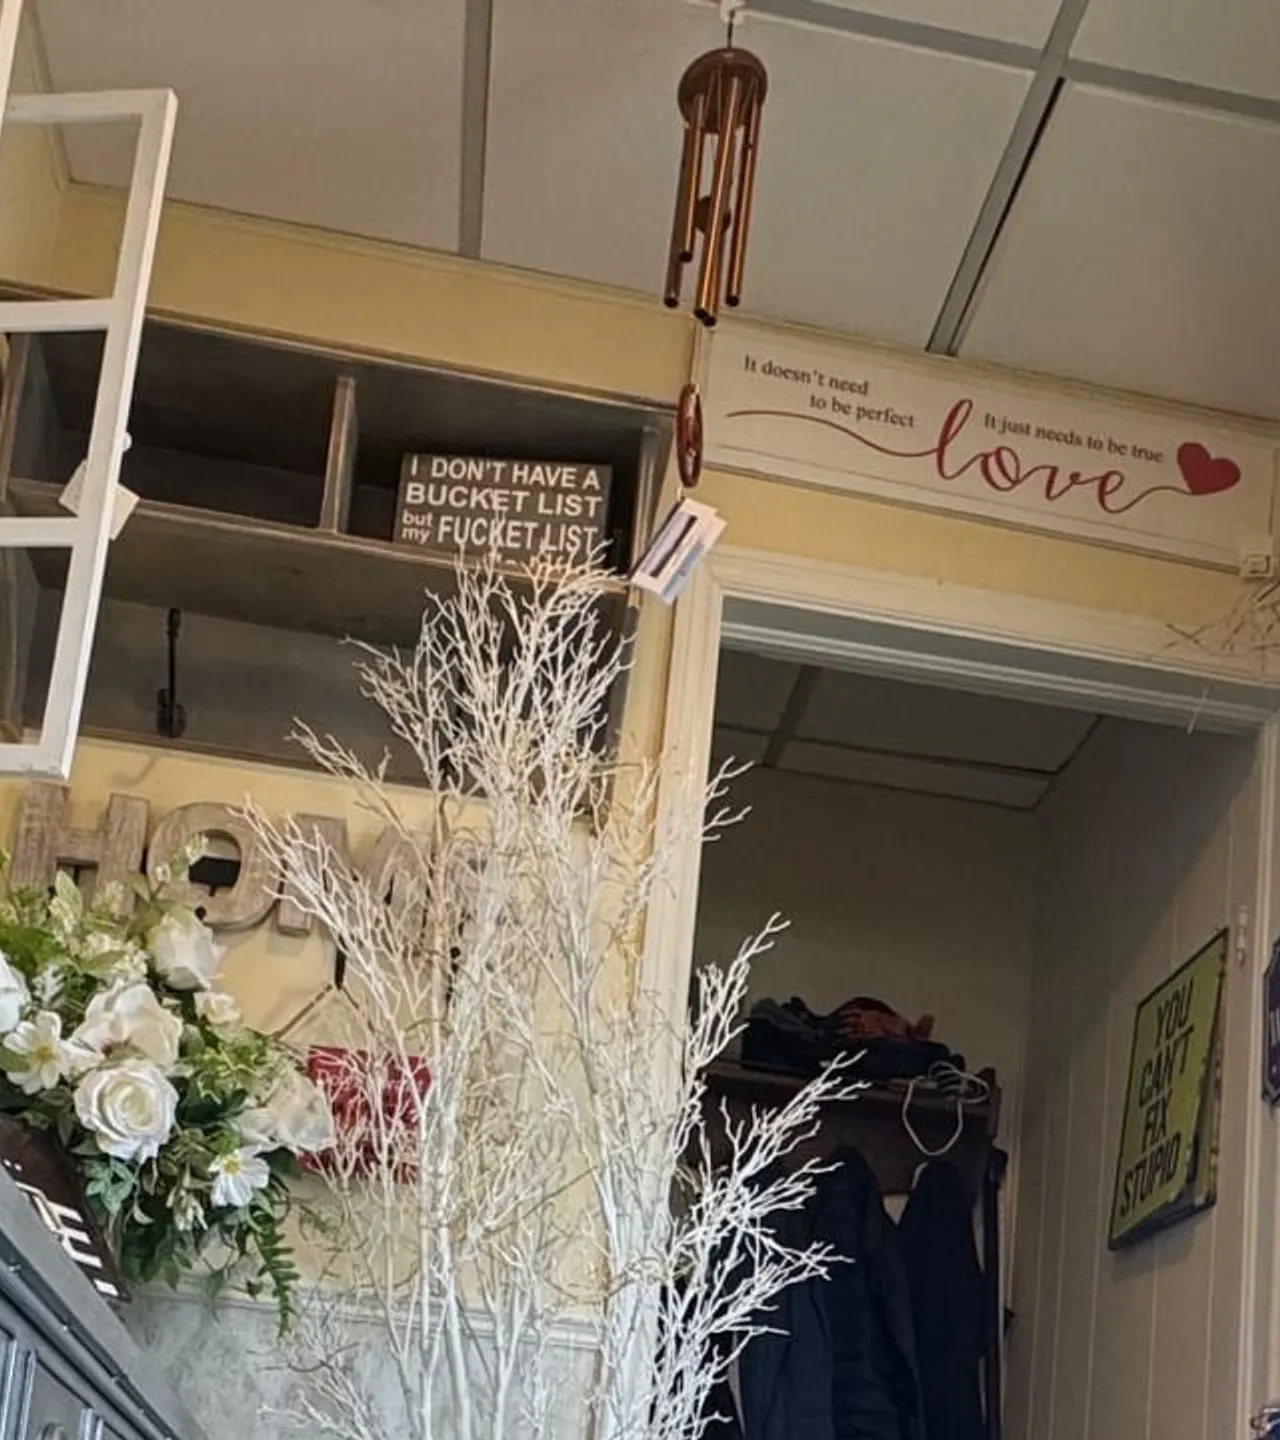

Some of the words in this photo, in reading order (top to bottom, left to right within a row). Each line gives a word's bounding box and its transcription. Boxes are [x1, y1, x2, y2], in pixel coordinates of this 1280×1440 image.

[743, 354, 757, 374] It
[761, 360, 825, 387] doesn't
[829, 375, 869, 396] need
[809, 394, 827, 409] to
[831, 396, 852, 416] be
[855, 405, 915, 429] perfect
[932, 399, 1130, 514] love
[984, 412, 996, 429] It
[999, 416, 1031, 435] just
[1035, 425, 1083, 448] needs
[1087, 435, 1103, 451] to
[1107, 437, 1128, 456] be
[1131, 444, 1164, 463] true
[411, 454, 418, 476] I
[431, 457, 506, 483] DON'T
[512, 464, 577, 489] HAVE
[582, 468, 600, 490] A
[402, 509, 433, 526] but
[406, 482, 530, 513] BUCKET
[538, 493, 603, 518] LIST
[402, 527, 432, 545] my
[437, 515, 539, 550] FUCKET
[542, 523, 598, 556] LIST
[1156, 976, 1194, 1047] YOU
[1121, 1132, 1181, 1216] STUPID
